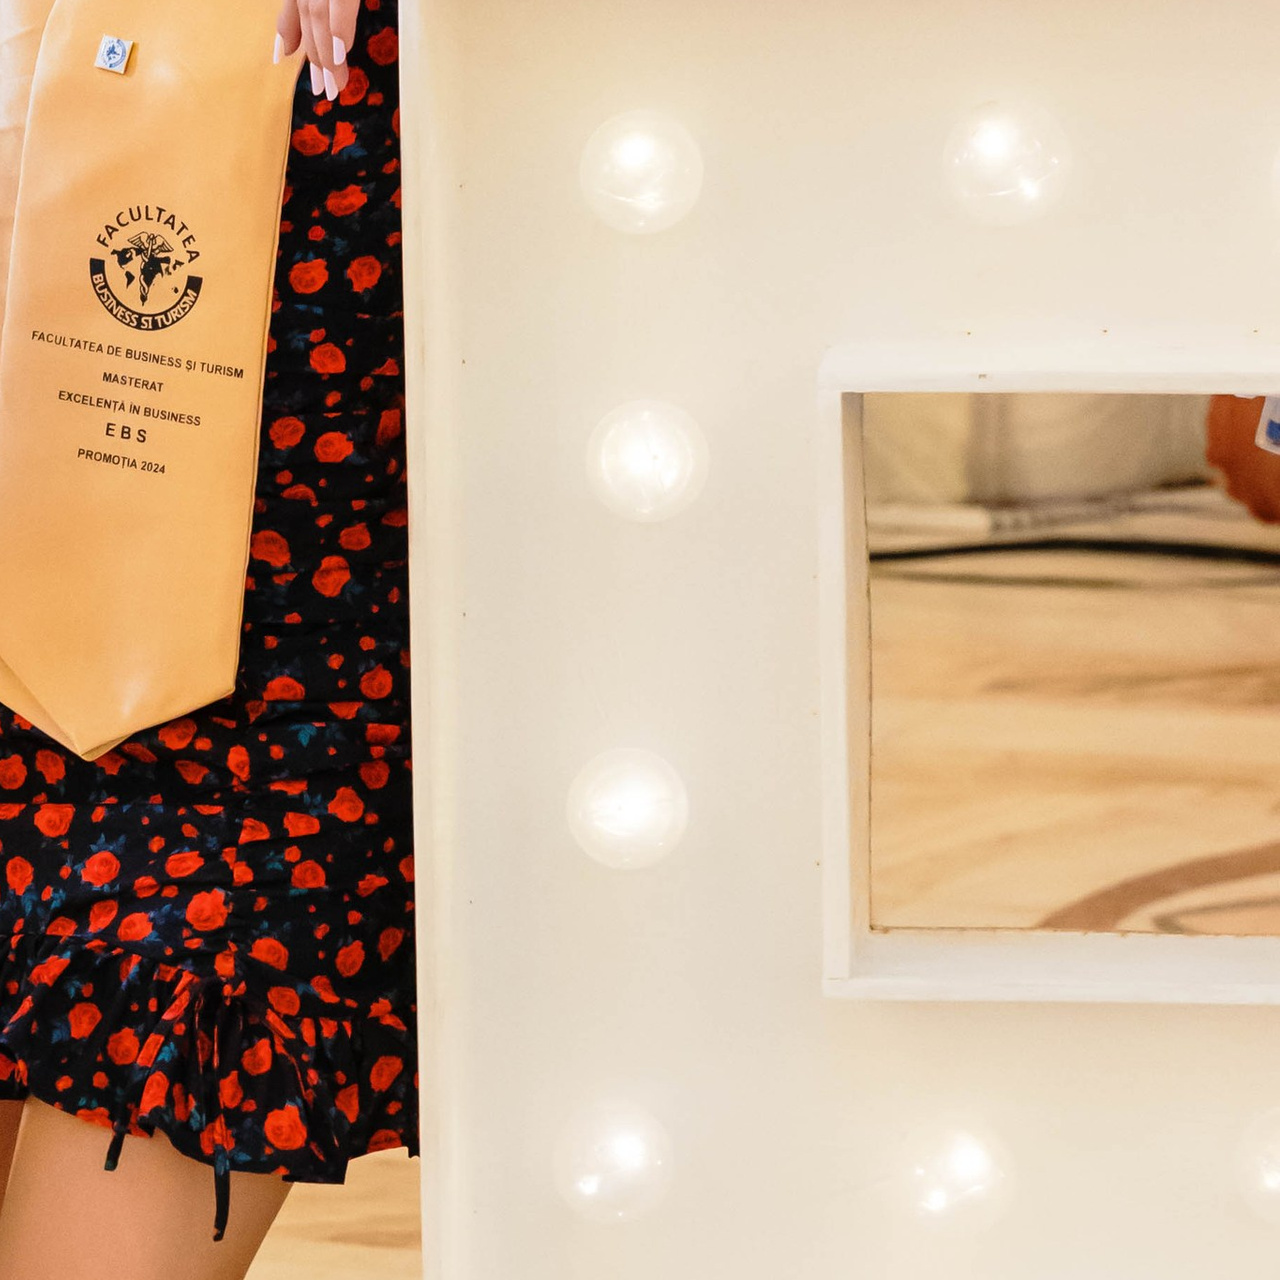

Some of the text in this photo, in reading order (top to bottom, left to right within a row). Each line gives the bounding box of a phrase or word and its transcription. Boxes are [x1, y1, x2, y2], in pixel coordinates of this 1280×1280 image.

[96, 204, 200, 264] FACULTATEA
[92, 272, 140, 327] BUSINESS
[154, 289, 198, 328] TURISM
[31, 330, 104, 354] FACULTATEA
[106, 344, 123, 357] DE
[125, 348, 183, 368] BUSINESS
[199, 362, 245, 379] TURISM
[102, 372, 164, 393] MASTERAT
[143, 406, 201, 427] BUSINESS
[140, 461, 166, 474] 2024
